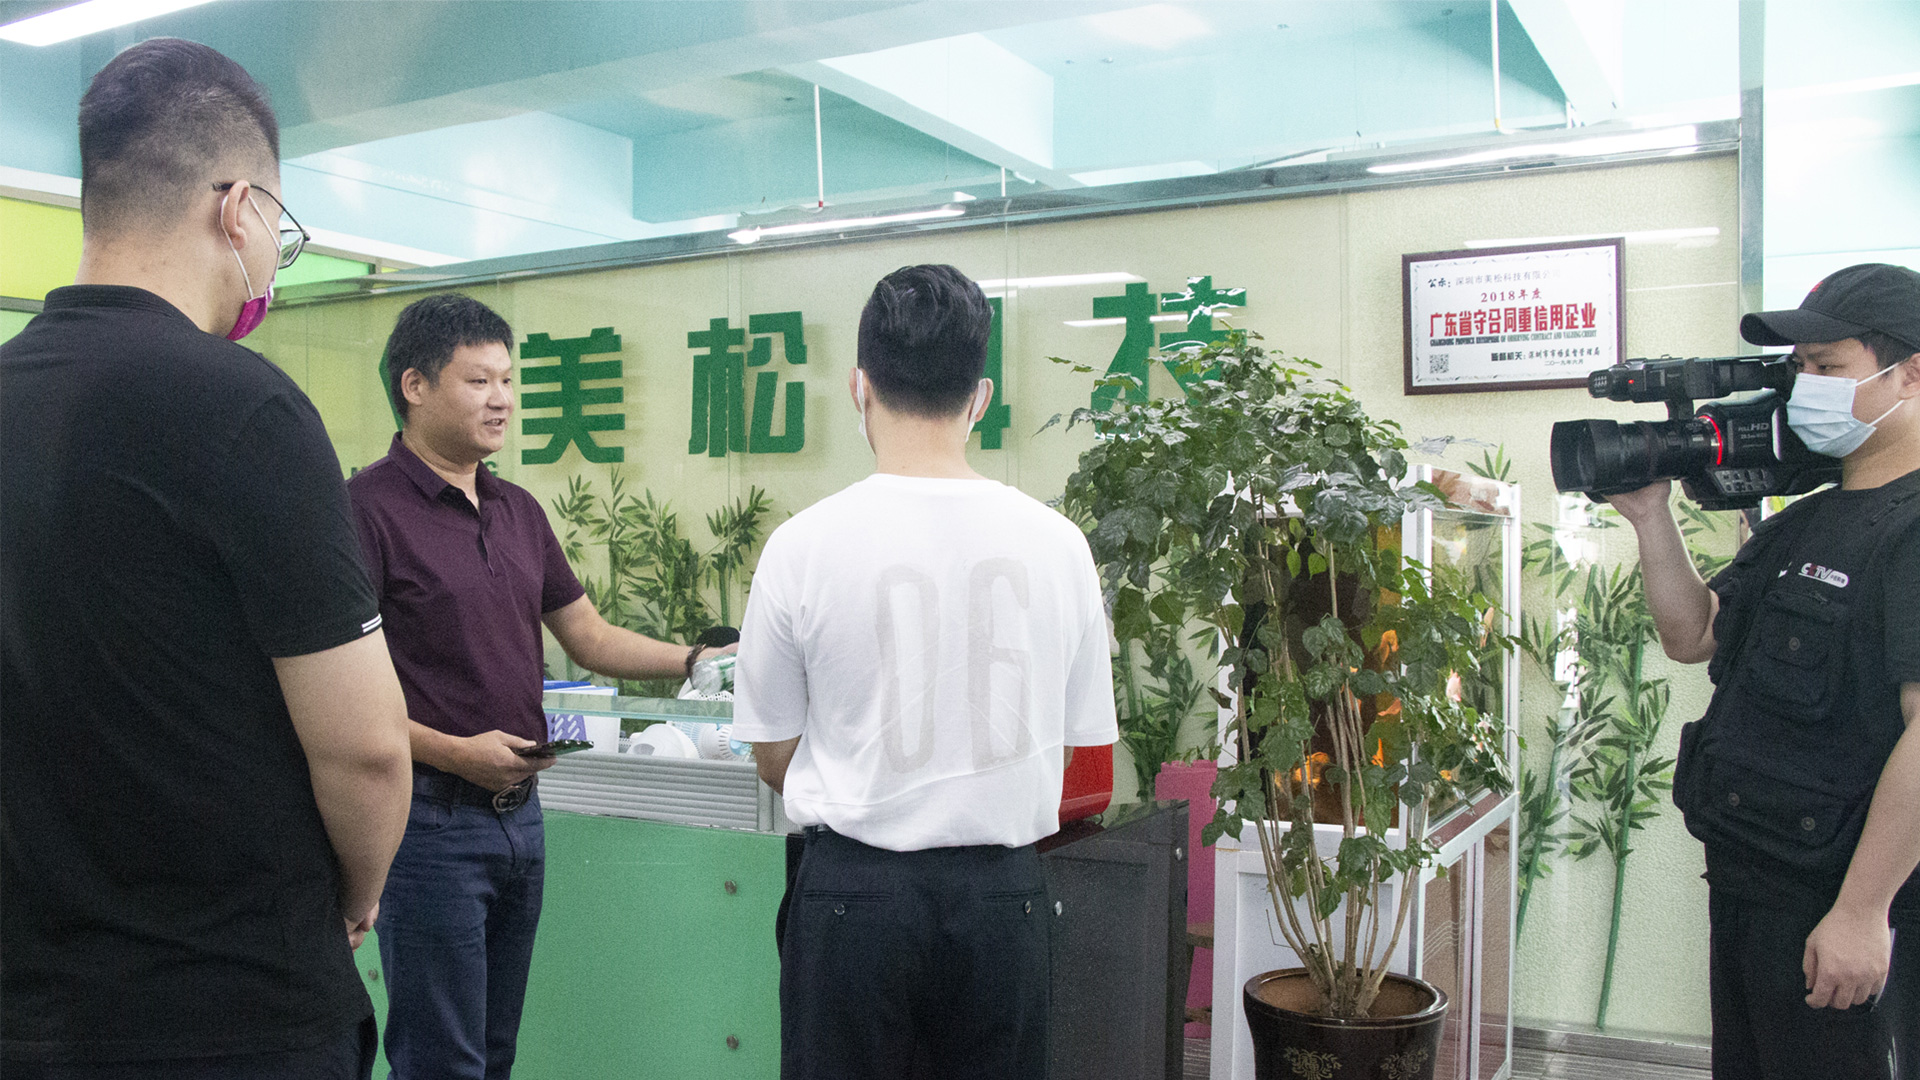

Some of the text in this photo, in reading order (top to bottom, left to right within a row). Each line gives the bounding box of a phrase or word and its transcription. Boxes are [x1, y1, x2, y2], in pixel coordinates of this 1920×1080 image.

[1480, 287, 1542, 303] 2018年度
[1429, 302, 1597, 337] 广东省守合同重信用企业
[1750, 422, 1769, 431] HD
[875, 556, 1032, 774] 06
